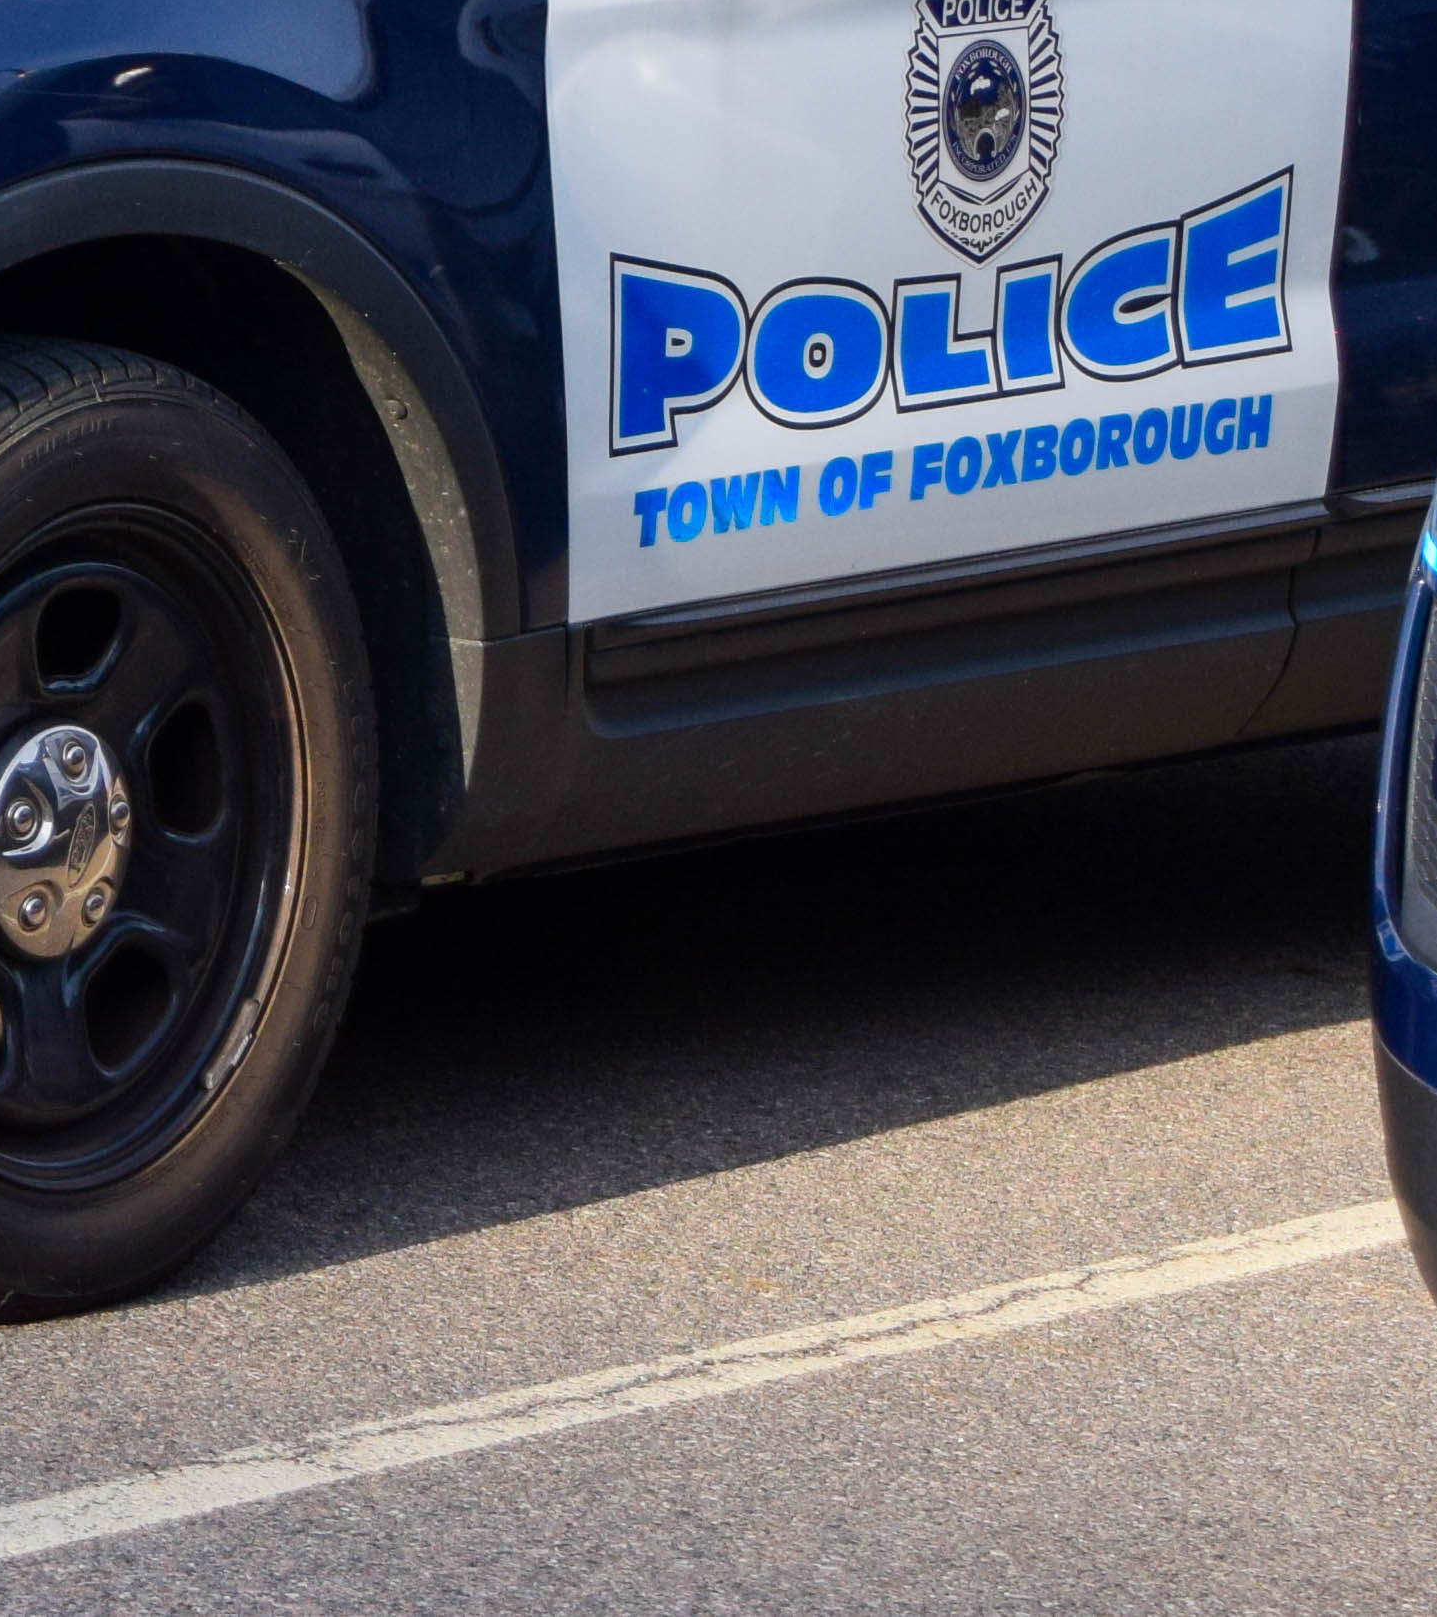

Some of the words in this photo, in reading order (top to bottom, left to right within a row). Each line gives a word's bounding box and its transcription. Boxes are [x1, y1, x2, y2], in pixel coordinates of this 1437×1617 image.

[954, 47, 1013, 81] FOXBOROUGH
[929, 177, 1039, 233] FOXBOROUGH
[610, 165, 1294, 457] POLICE
[634, 467, 799, 548] TOWN
[818, 451, 893, 517] OF
[910, 394, 1274, 502] FOXBOROUGH
